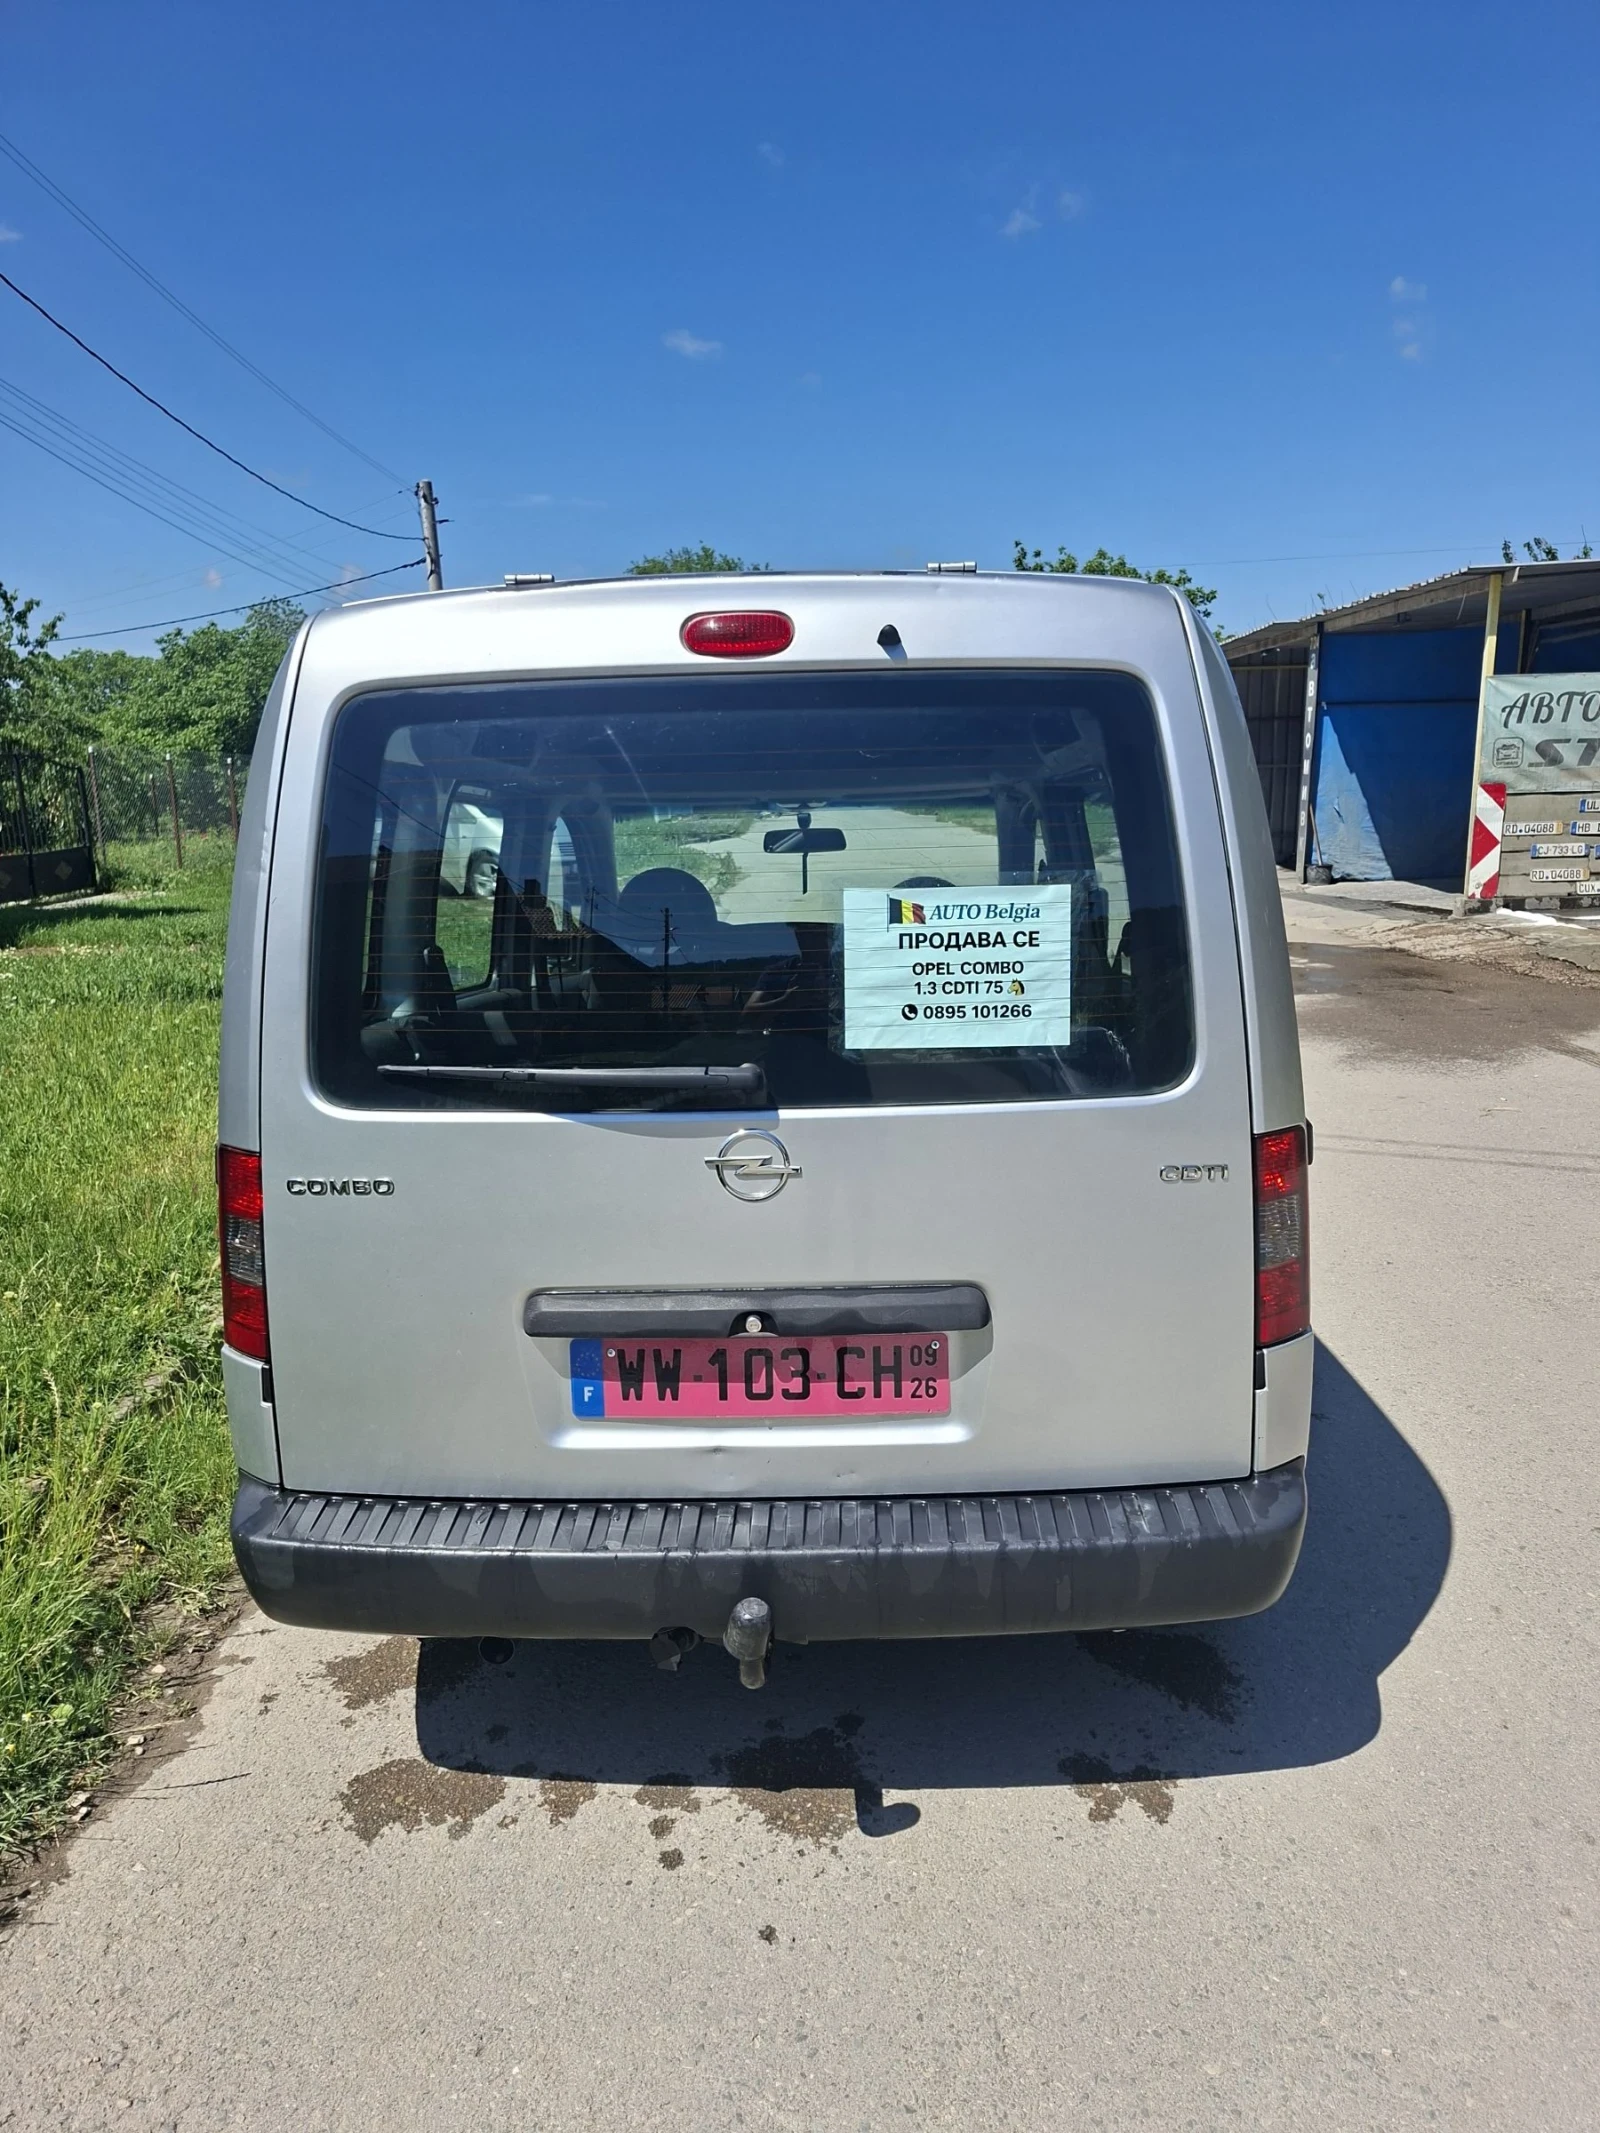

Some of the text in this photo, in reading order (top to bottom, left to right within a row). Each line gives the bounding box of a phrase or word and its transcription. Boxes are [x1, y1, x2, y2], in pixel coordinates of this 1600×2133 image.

[1577, 823, 1591, 833] HB
[929, 903, 1041, 923] AUTO Belgia
[899, 930, 1040, 951] ПРОДАВА СЕ
[912, 961, 1024, 976] OPEL COMBO
[914, 981, 1003, 995] 1.3 CDTI 75
[923, 1004, 1032, 1019] 0895 101266
[1160, 1163, 1229, 1183] CDTI
[286, 1179, 395, 1196] COMBO
[583, 1386, 595, 1403] F
[910, 1377, 938, 1399] 26
